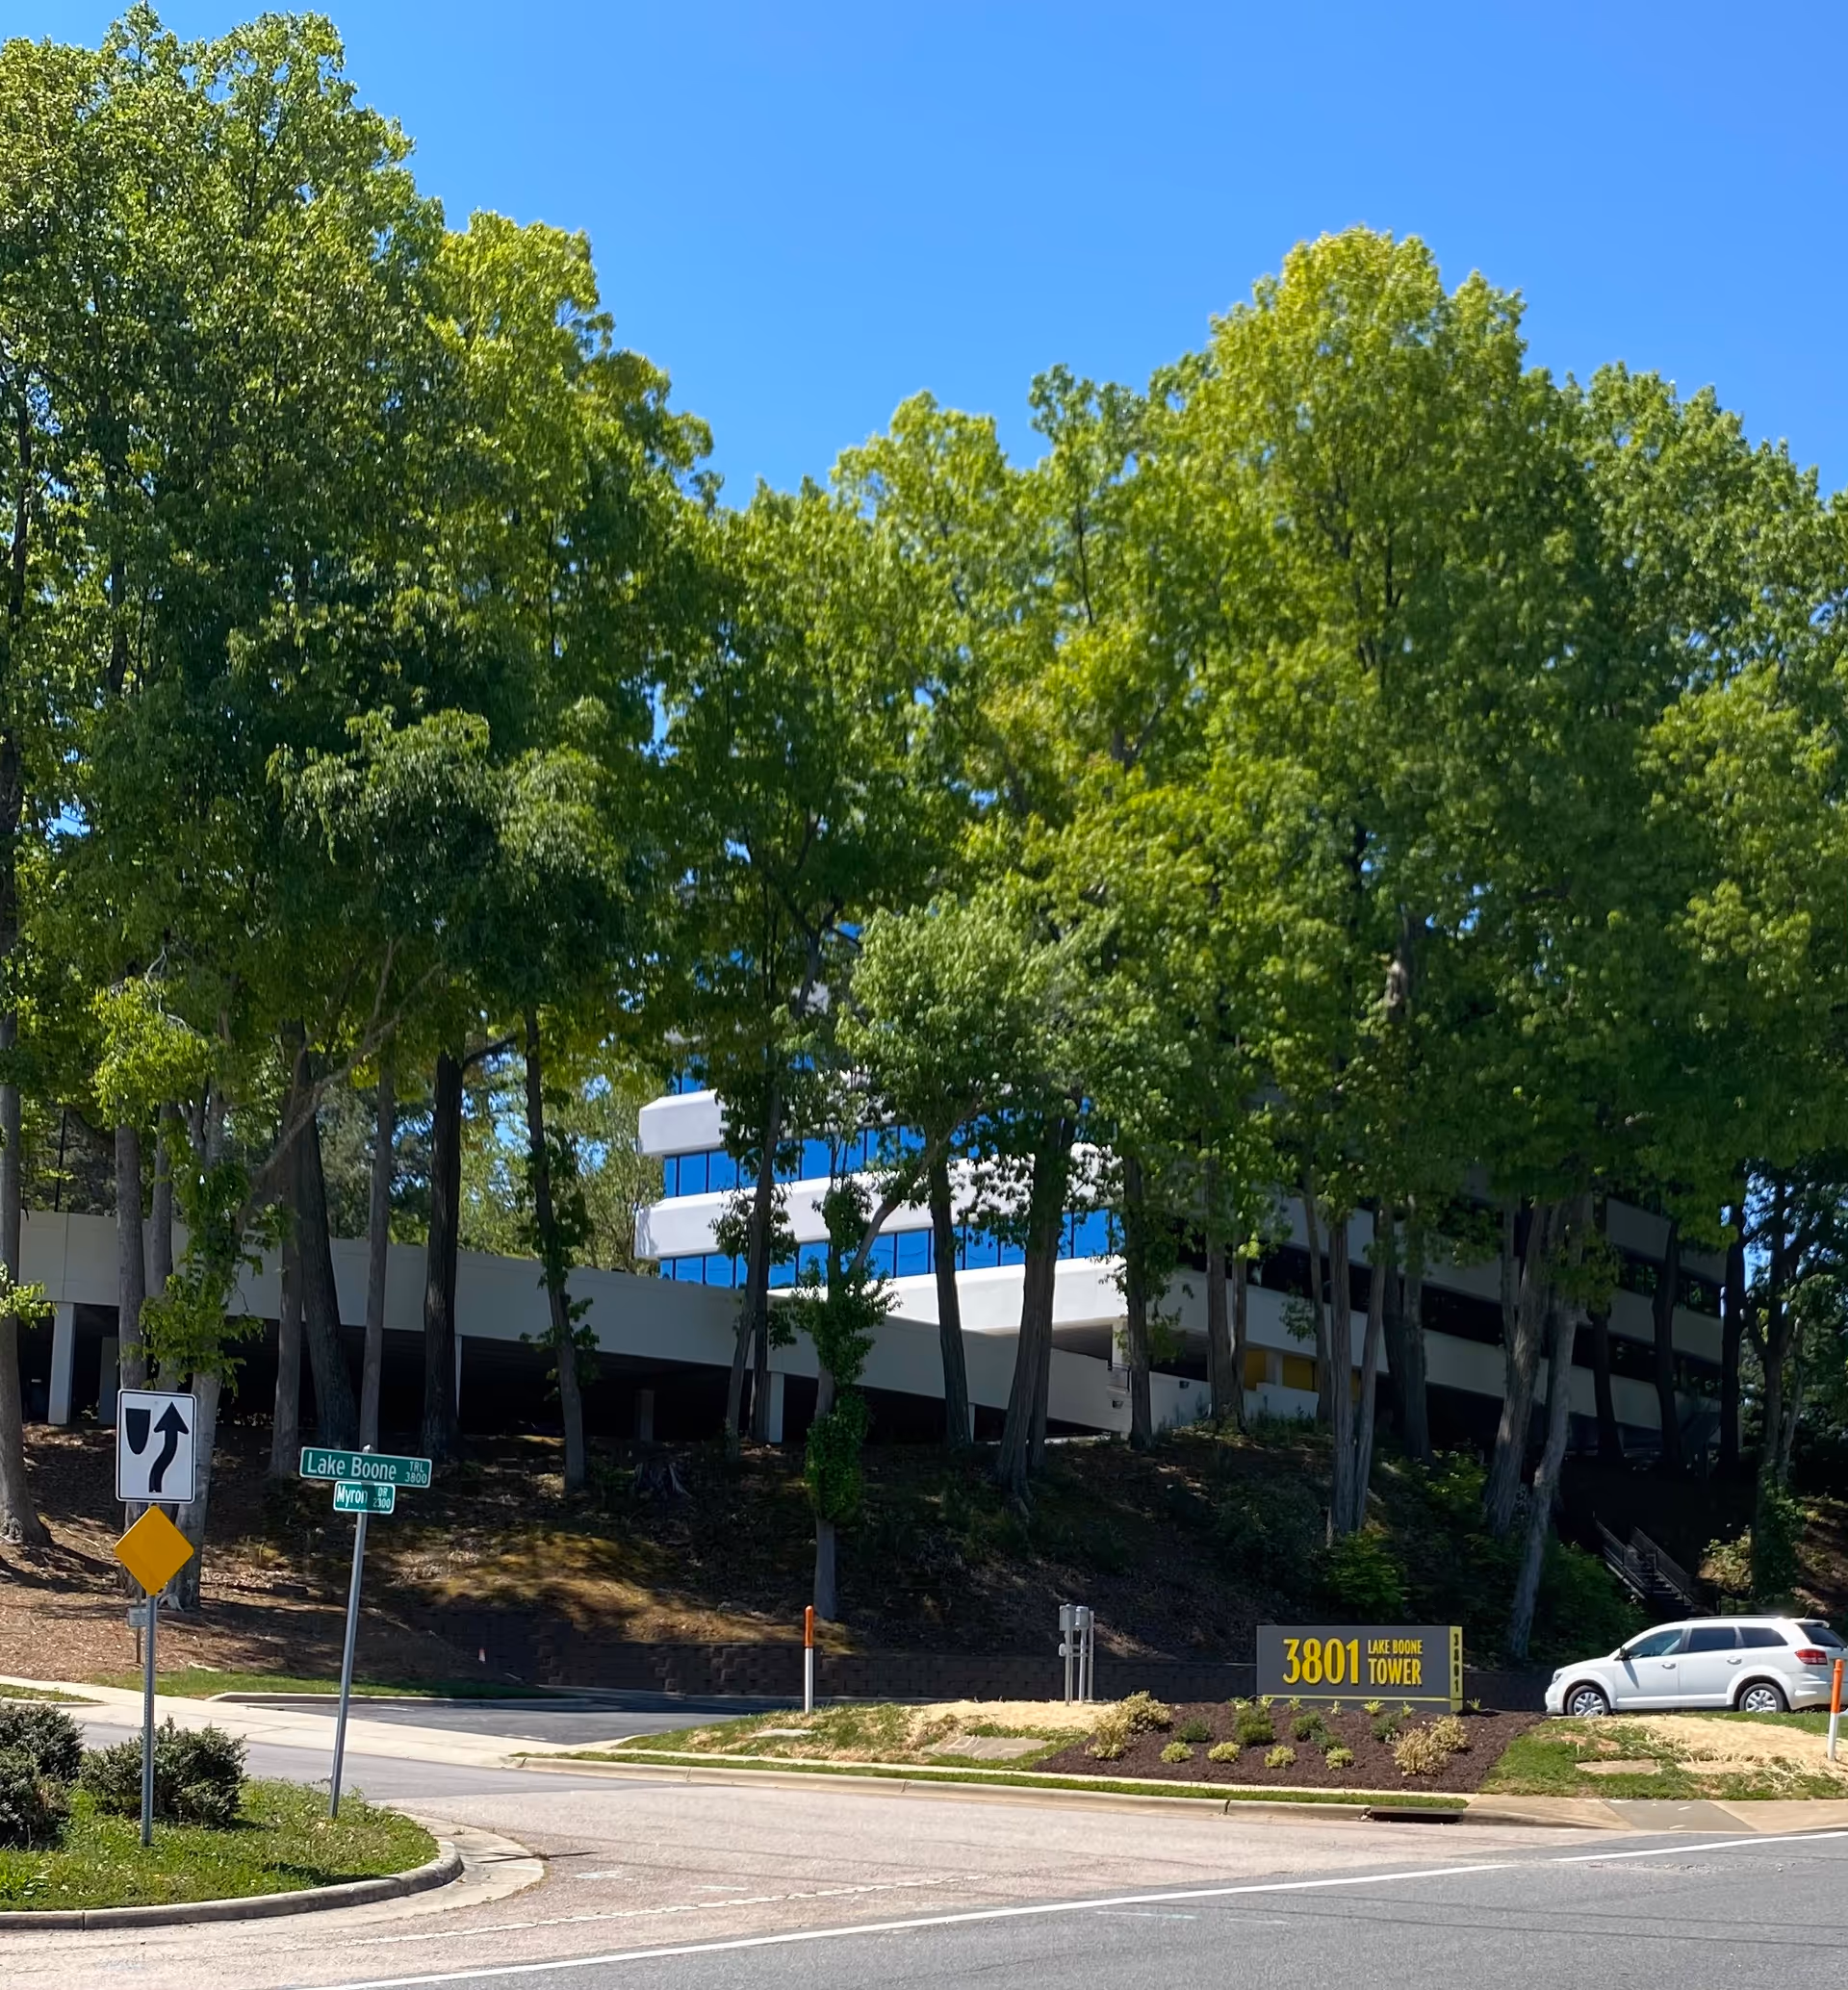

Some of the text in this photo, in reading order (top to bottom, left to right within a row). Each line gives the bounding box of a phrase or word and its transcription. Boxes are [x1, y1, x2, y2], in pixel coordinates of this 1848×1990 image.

[307, 1452, 397, 1481] Lake Boone
[409, 1461, 424, 1473] TRL
[404, 1471, 427, 1484] 3800
[337, 1485, 368, 1508] Myron
[377, 1487, 388, 1497] DR
[372, 1497, 392, 1509] 2300
[1368, 1639, 1423, 1655] LAKE BOONE
[1282, 1638, 1359, 1685] 3801
[1368, 1658, 1423, 1685] TOWER
